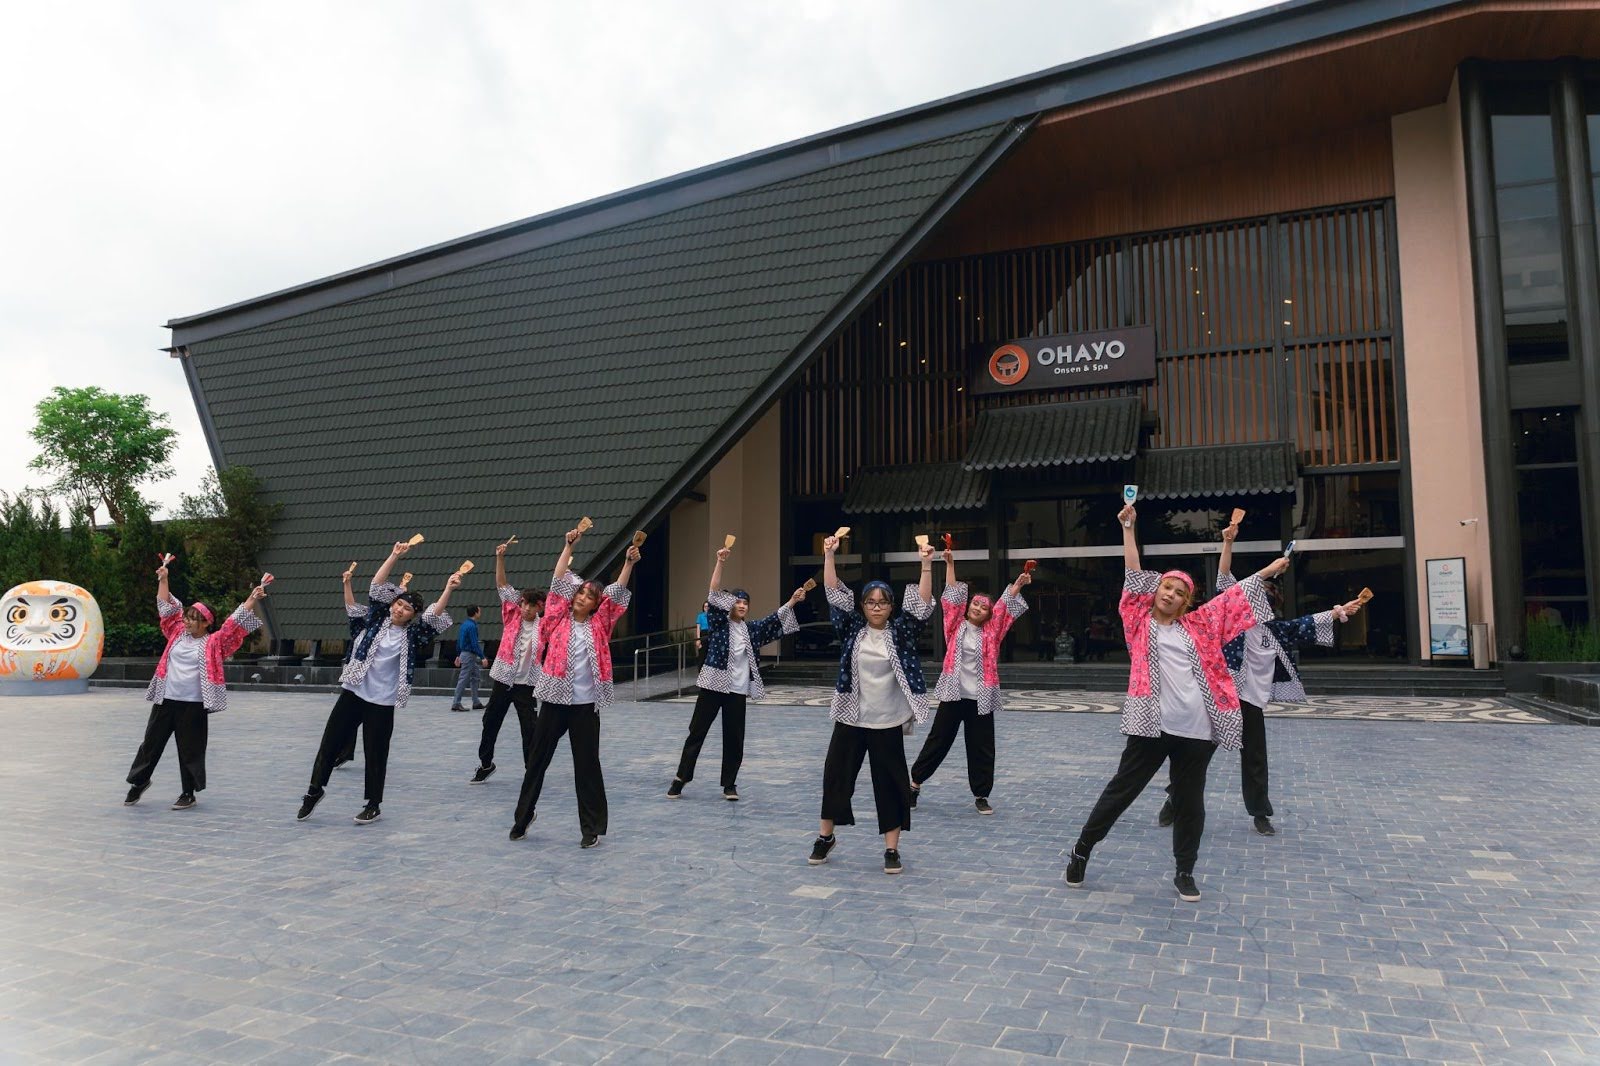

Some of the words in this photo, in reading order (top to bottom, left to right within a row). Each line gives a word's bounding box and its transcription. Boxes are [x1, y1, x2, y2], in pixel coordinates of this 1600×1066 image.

[1037, 340, 1125, 366] OHAYO
[1054, 367, 1081, 375] Onsen
[1092, 363, 1109, 372] Spa
